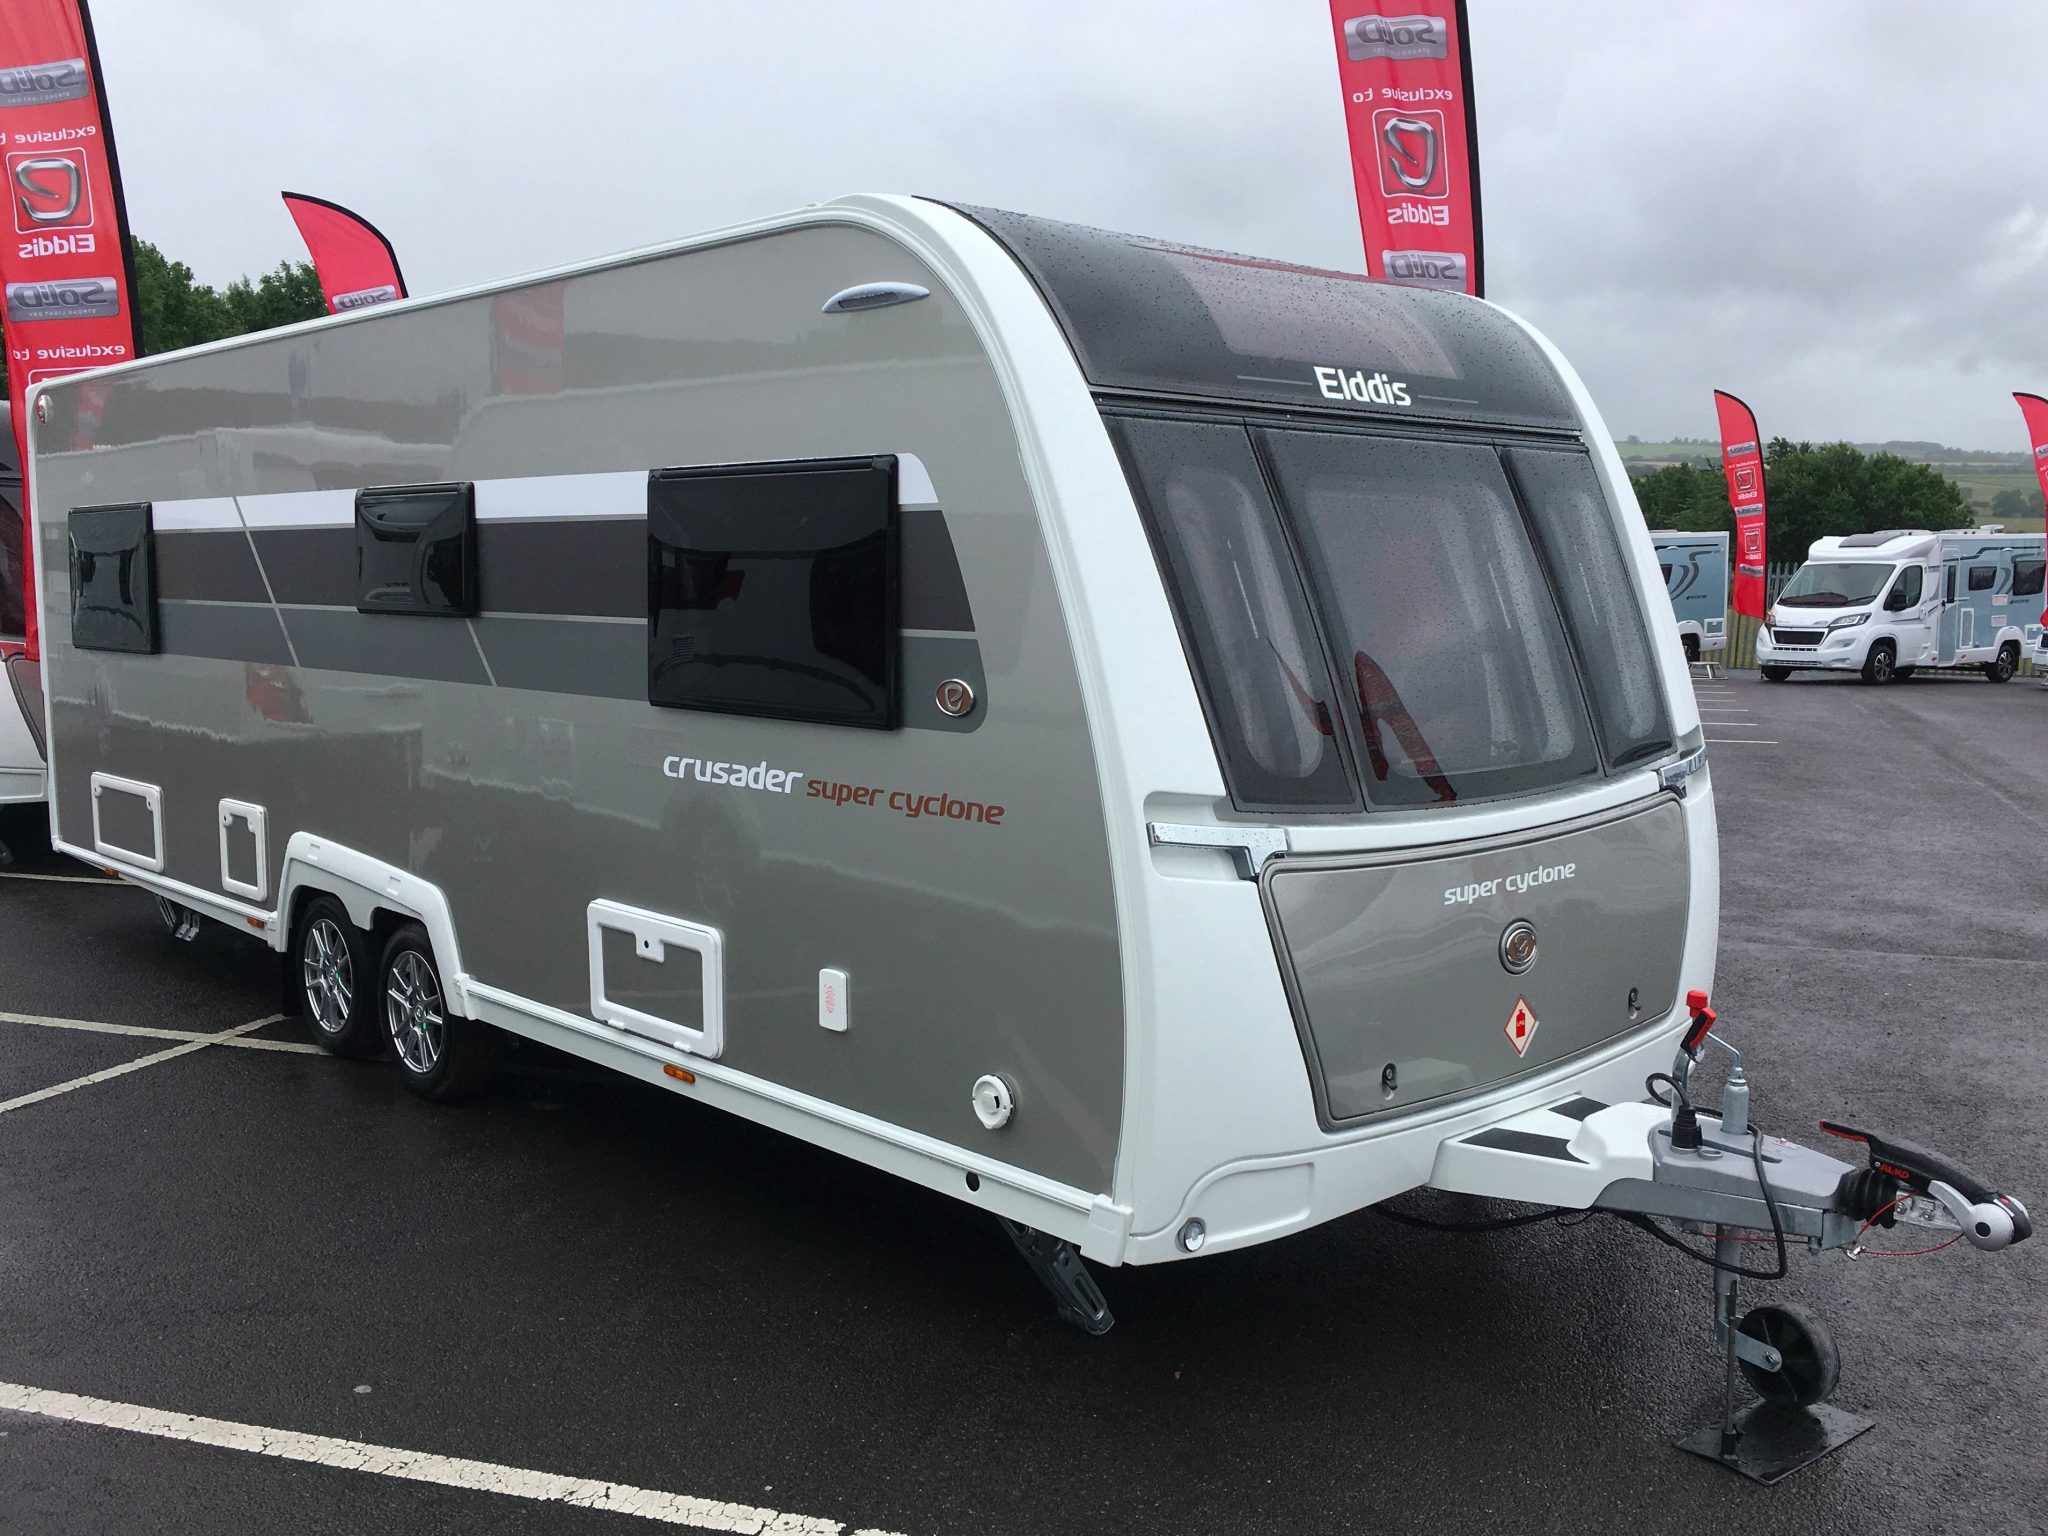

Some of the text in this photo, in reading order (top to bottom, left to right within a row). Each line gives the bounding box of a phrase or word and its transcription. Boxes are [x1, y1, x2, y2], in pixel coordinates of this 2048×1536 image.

[1312, 366, 1412, 406] Elddis
[663, 755, 1005, 826] crusader super cyclone
[1444, 862, 1577, 906] super cyclone
